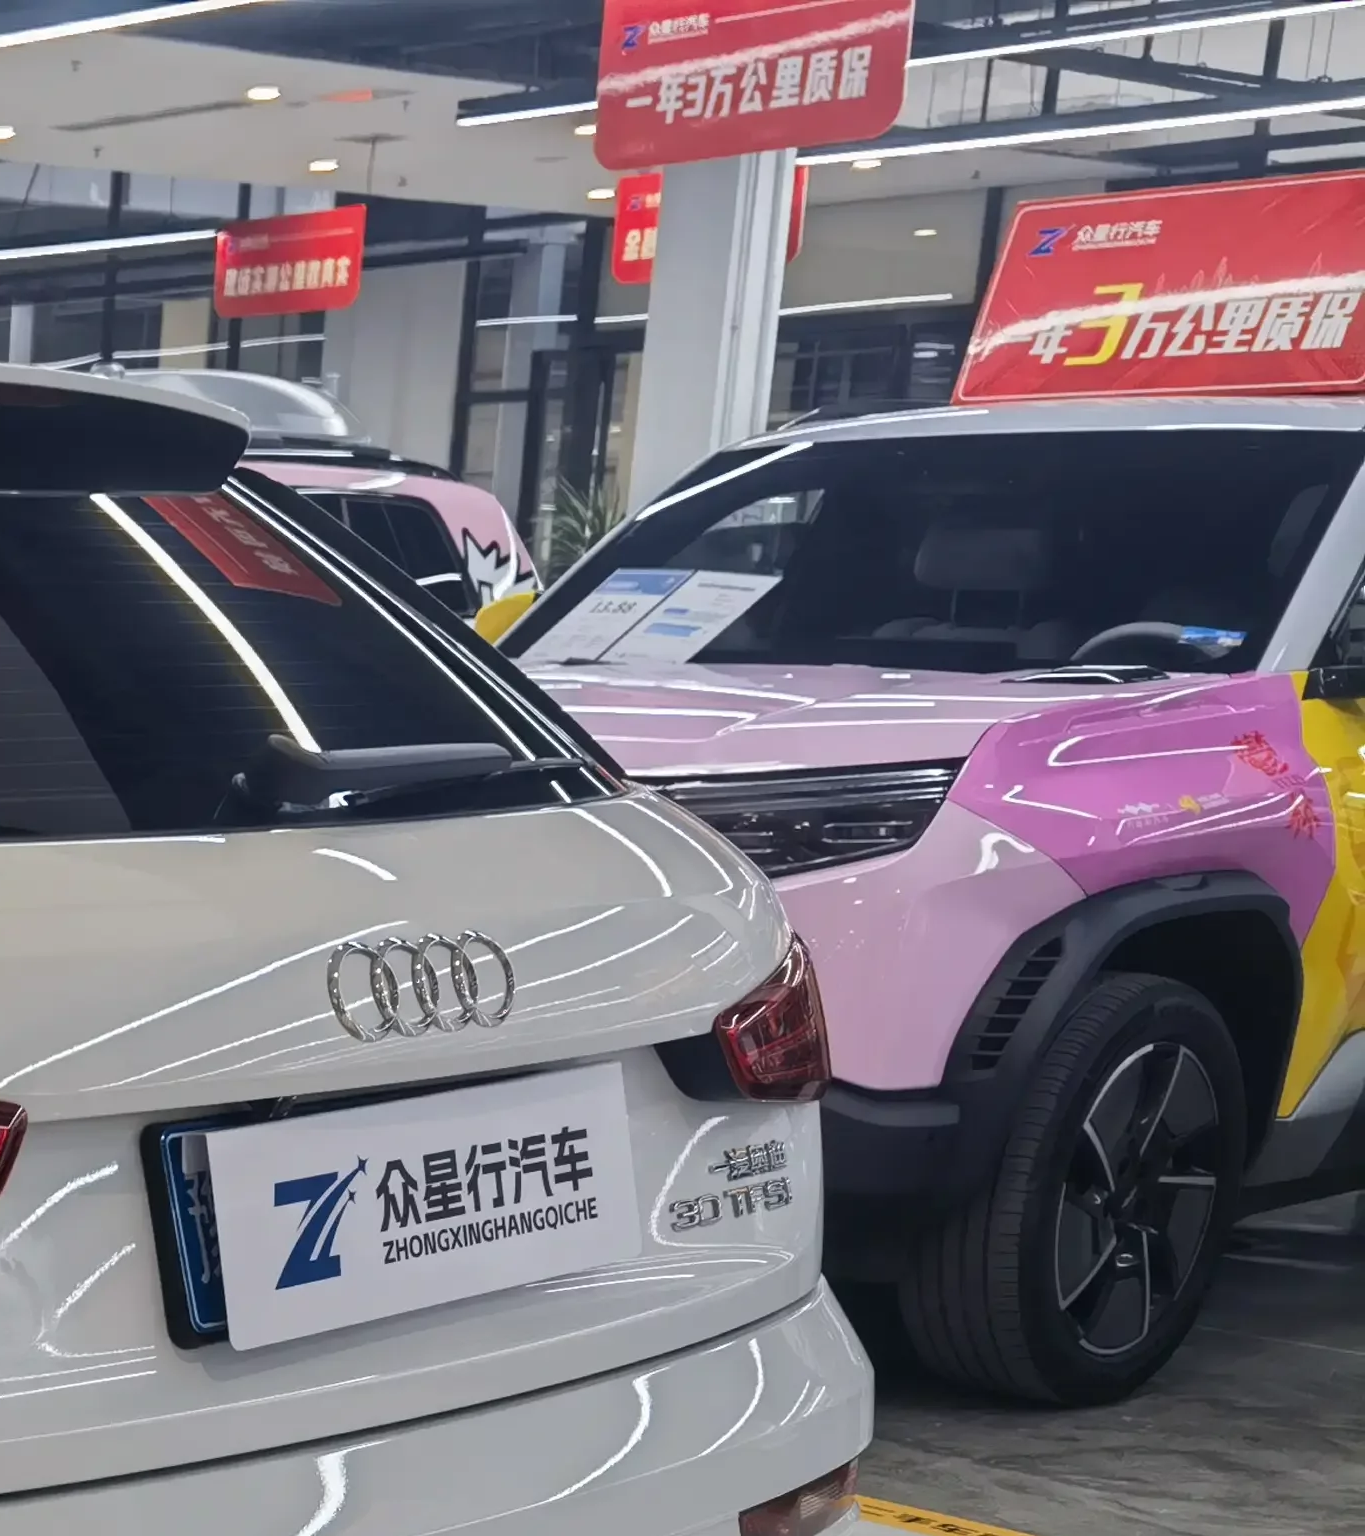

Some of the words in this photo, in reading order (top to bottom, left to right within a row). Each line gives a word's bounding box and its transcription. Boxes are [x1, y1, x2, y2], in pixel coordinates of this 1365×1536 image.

[626, 45, 872, 124] 一年3万公里质保
[1075, 220, 1162, 244] 众星行汽车
[1007, 282, 1360, 366] 一年3万公里质保
[376, 1126, 593, 1232] 众星行汽车
[669, 1194, 723, 1232] 30
[722, 1176, 793, 1218] TFSI
[383, 1197, 598, 1264] ZHONGXINGHANGQICHE
